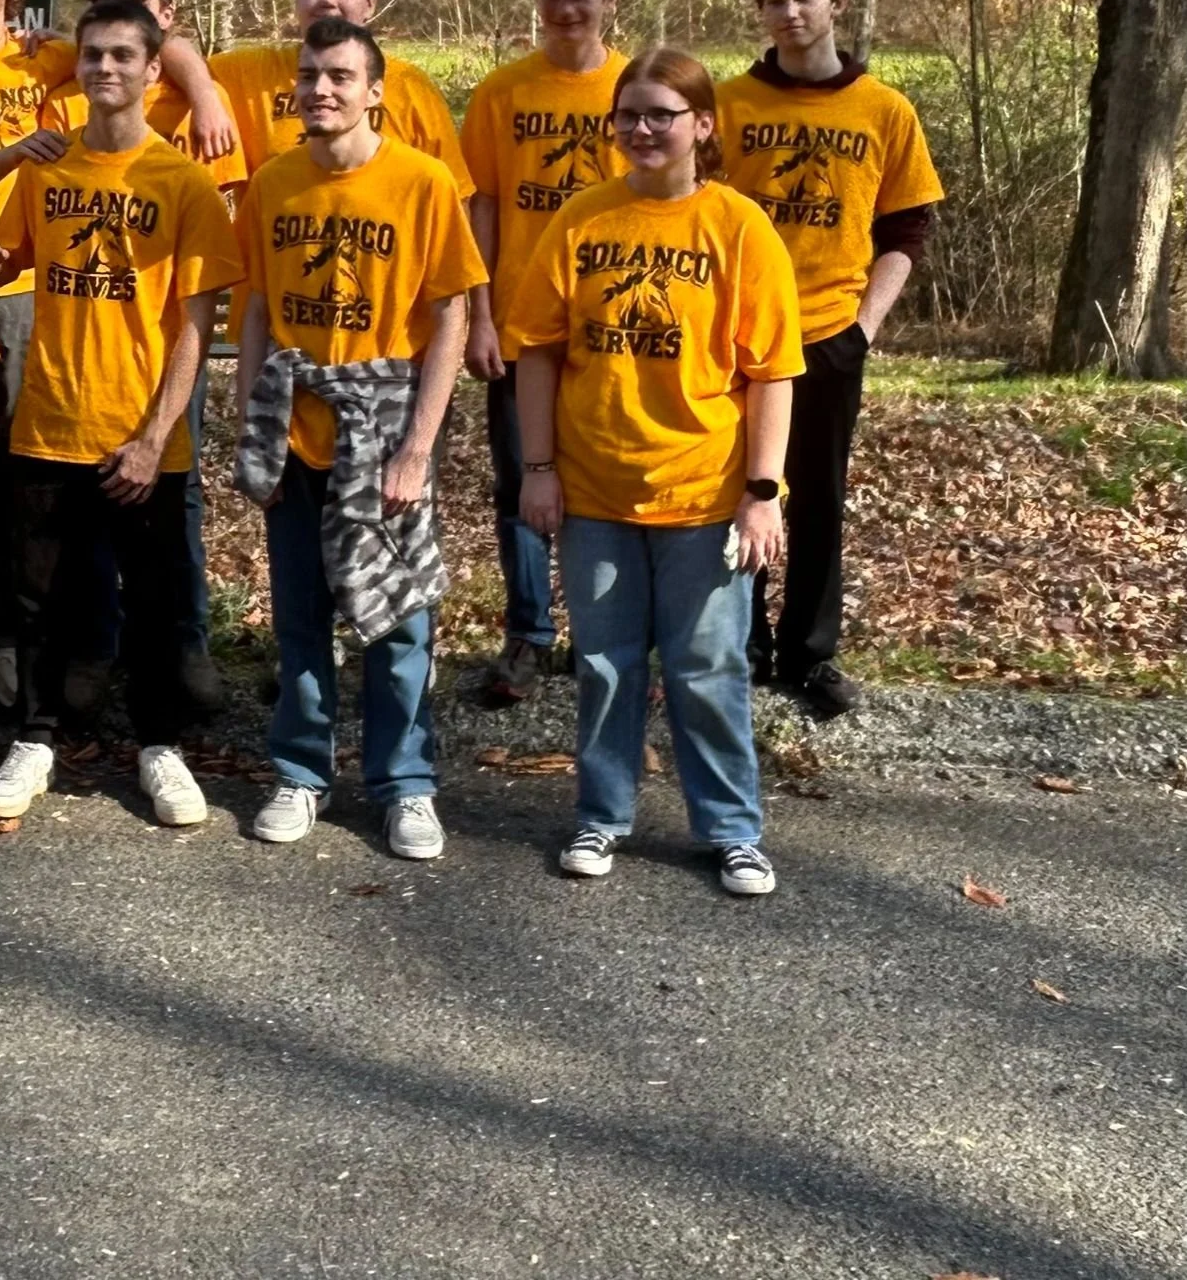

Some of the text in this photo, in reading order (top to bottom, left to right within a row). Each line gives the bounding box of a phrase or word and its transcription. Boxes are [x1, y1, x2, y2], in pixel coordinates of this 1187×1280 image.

[514, 112, 615, 145] SOLANC
[742, 123, 868, 162] SOLANCO
[45, 187, 158, 235] SOLANCO
[273, 215, 394, 256] SOLANCO
[576, 242, 712, 285] SOLANCO
[47, 265, 137, 302] SERVES
[282, 296, 372, 332] SERVES
